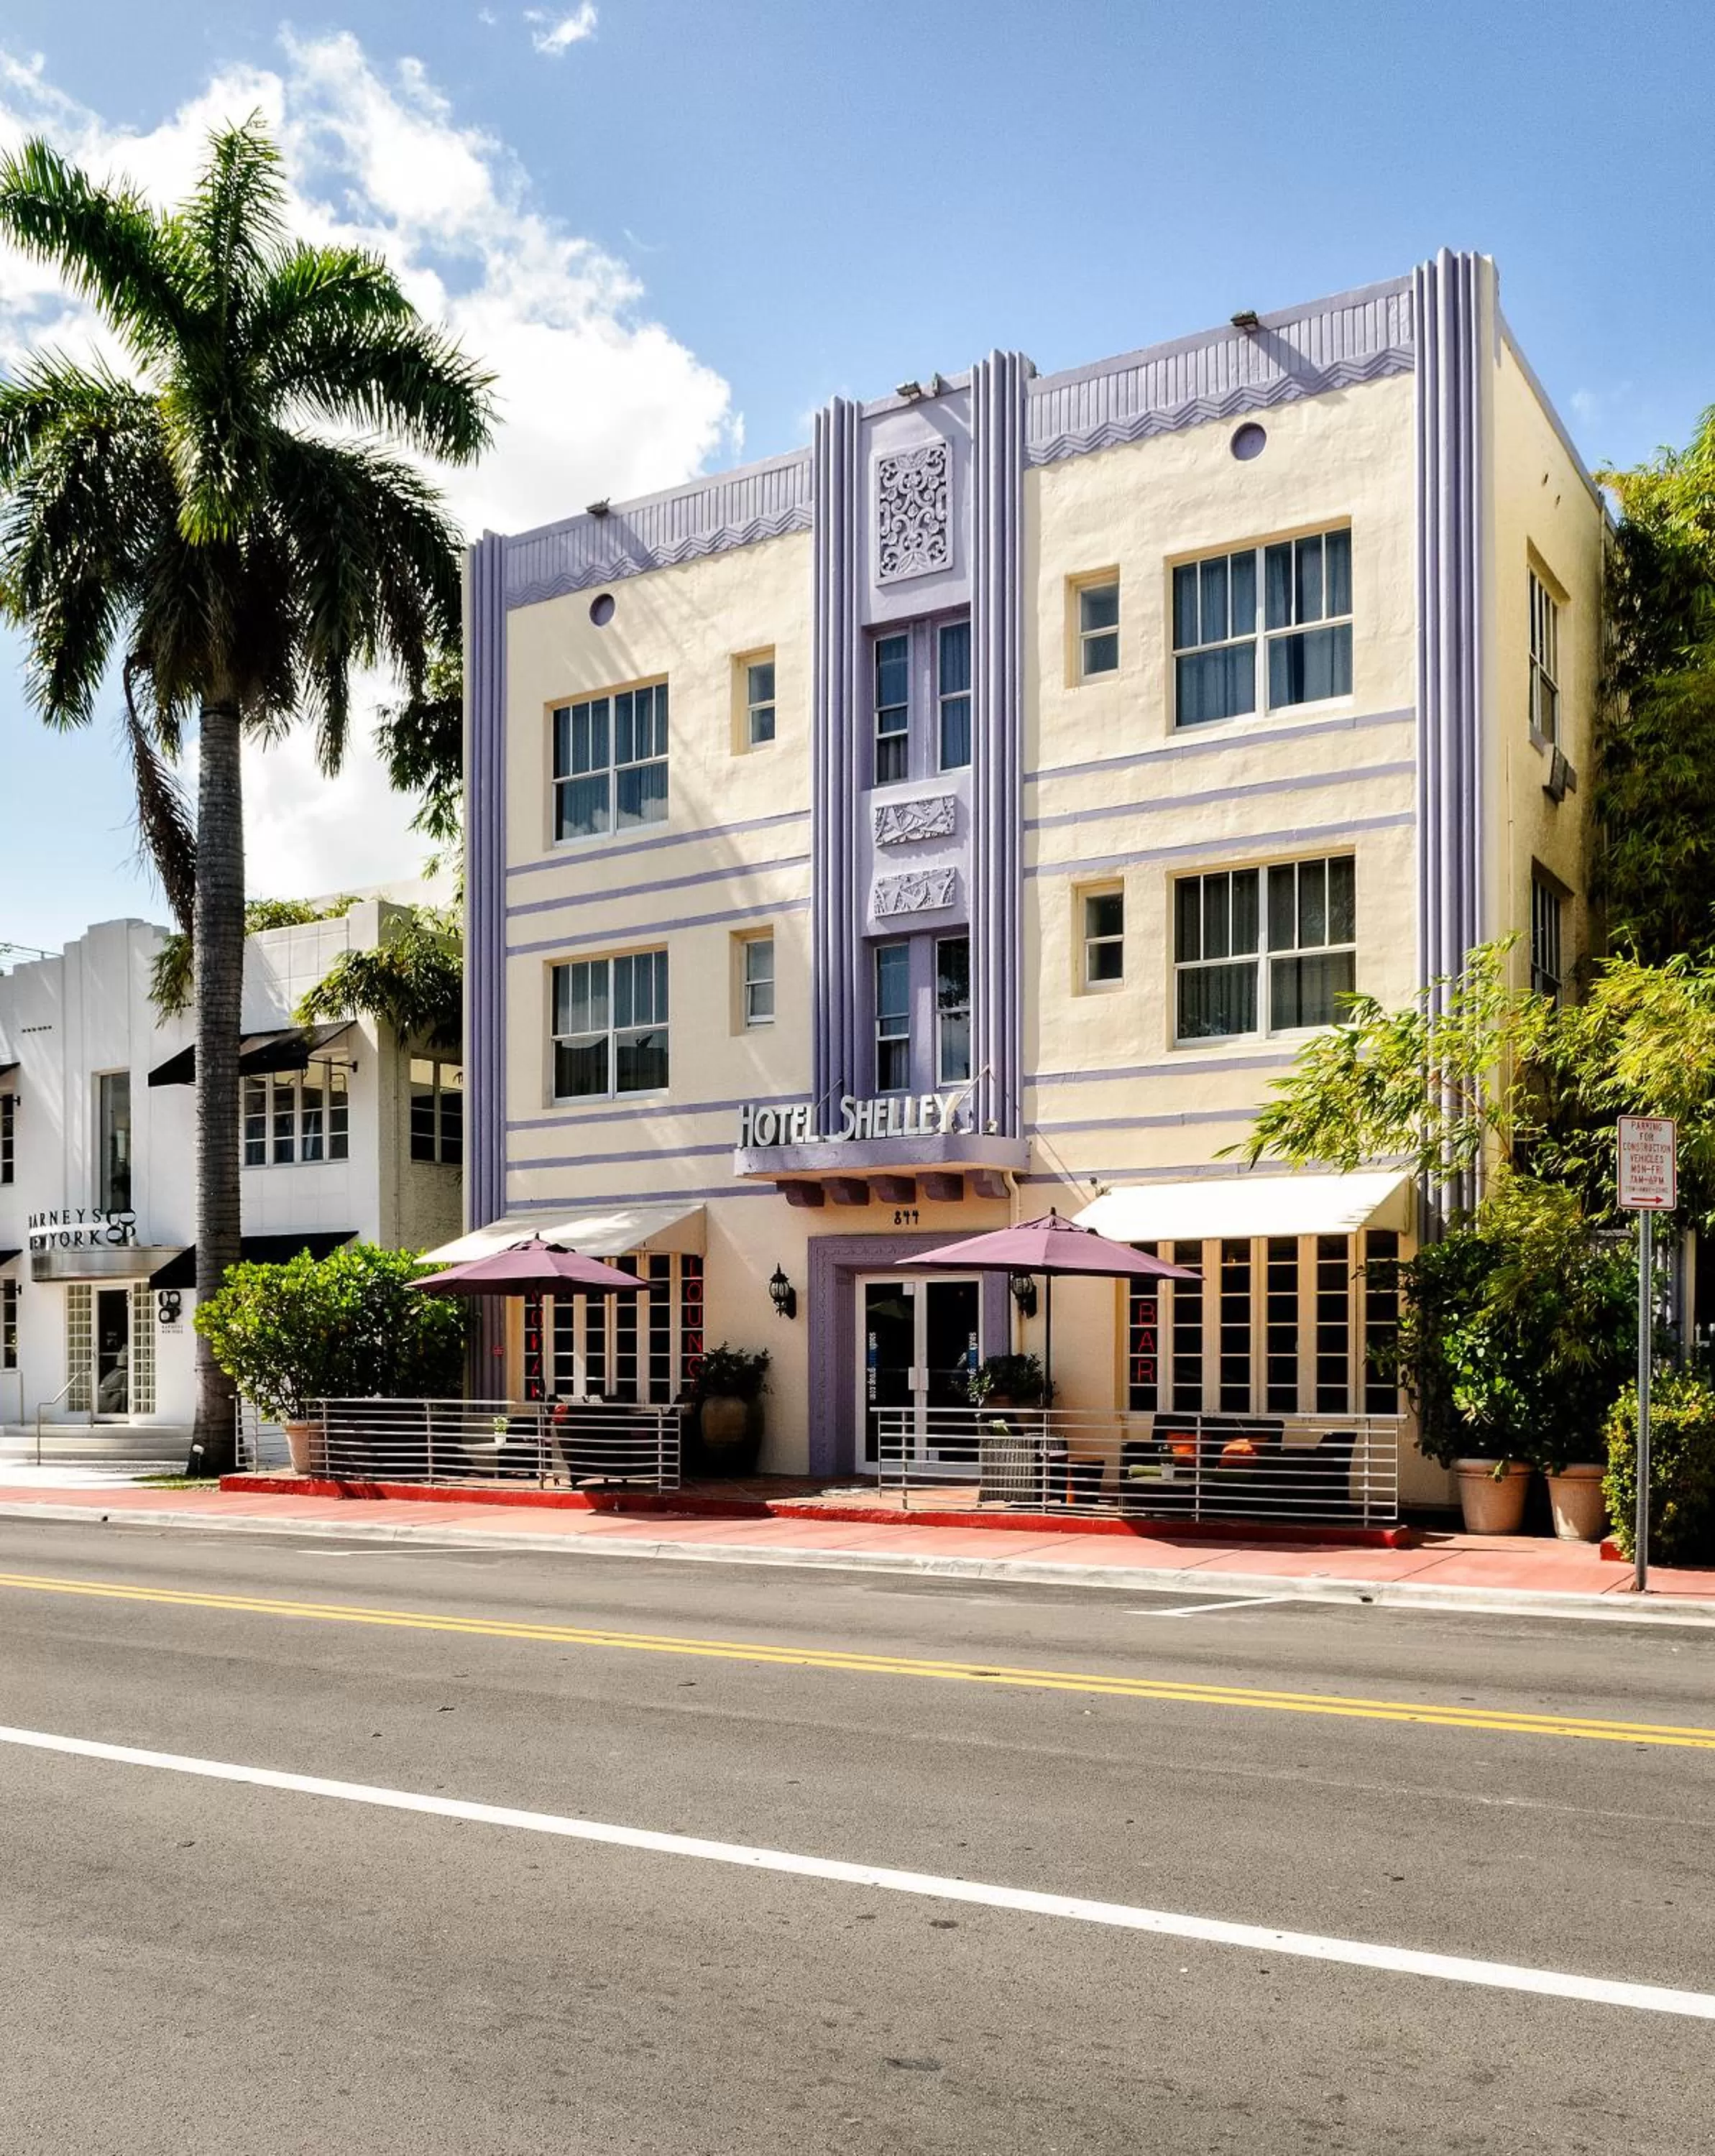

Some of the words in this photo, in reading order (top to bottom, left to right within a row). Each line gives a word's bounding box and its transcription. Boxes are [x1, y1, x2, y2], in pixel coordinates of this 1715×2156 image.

[738, 1104, 821, 1148] HOTEL
[838, 1092, 957, 1141] SHELLEY
[1631, 1121, 1663, 1132] PARKING
[1640, 1133, 1654, 1141] FOR
[1623, 1142, 1671, 1154] CONSTRUCTION
[1630, 1154, 1664, 1164] VEHICLES
[1631, 1165, 1663, 1174] MON-FRI
[893, 1210, 919, 1225] 844
[50, 1230, 102, 1247] YORK
[686, 1258, 704, 1394] LOUNG
[1138, 1303, 1156, 1383] BAR
